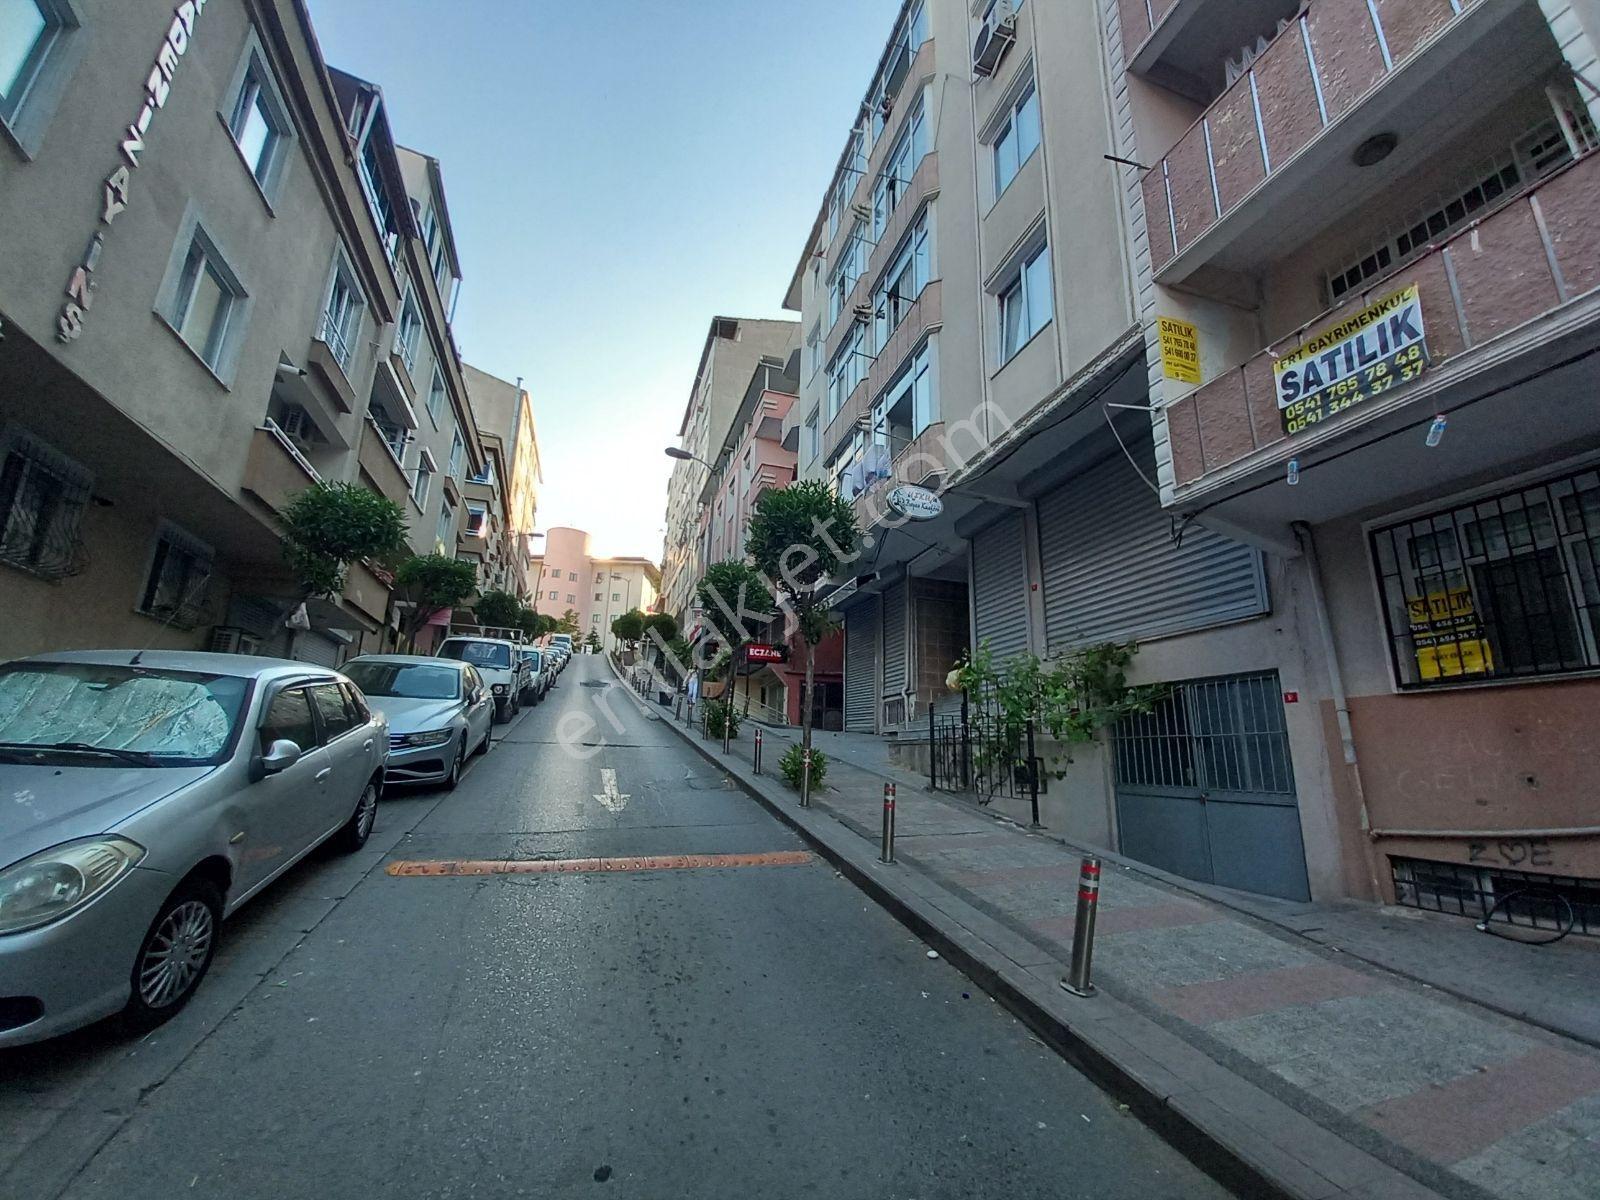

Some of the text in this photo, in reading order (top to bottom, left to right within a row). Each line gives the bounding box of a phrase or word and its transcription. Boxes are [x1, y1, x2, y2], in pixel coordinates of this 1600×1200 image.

[1161, 320, 1193, 339] SATILIK
[1280, 304, 1421, 403] SATILIK
[1284, 345, 1420, 419] 0541 765 78 48
[1287, 359, 1424, 434] 0541 344 37 37
[749, 648, 782, 658] ECZANE
